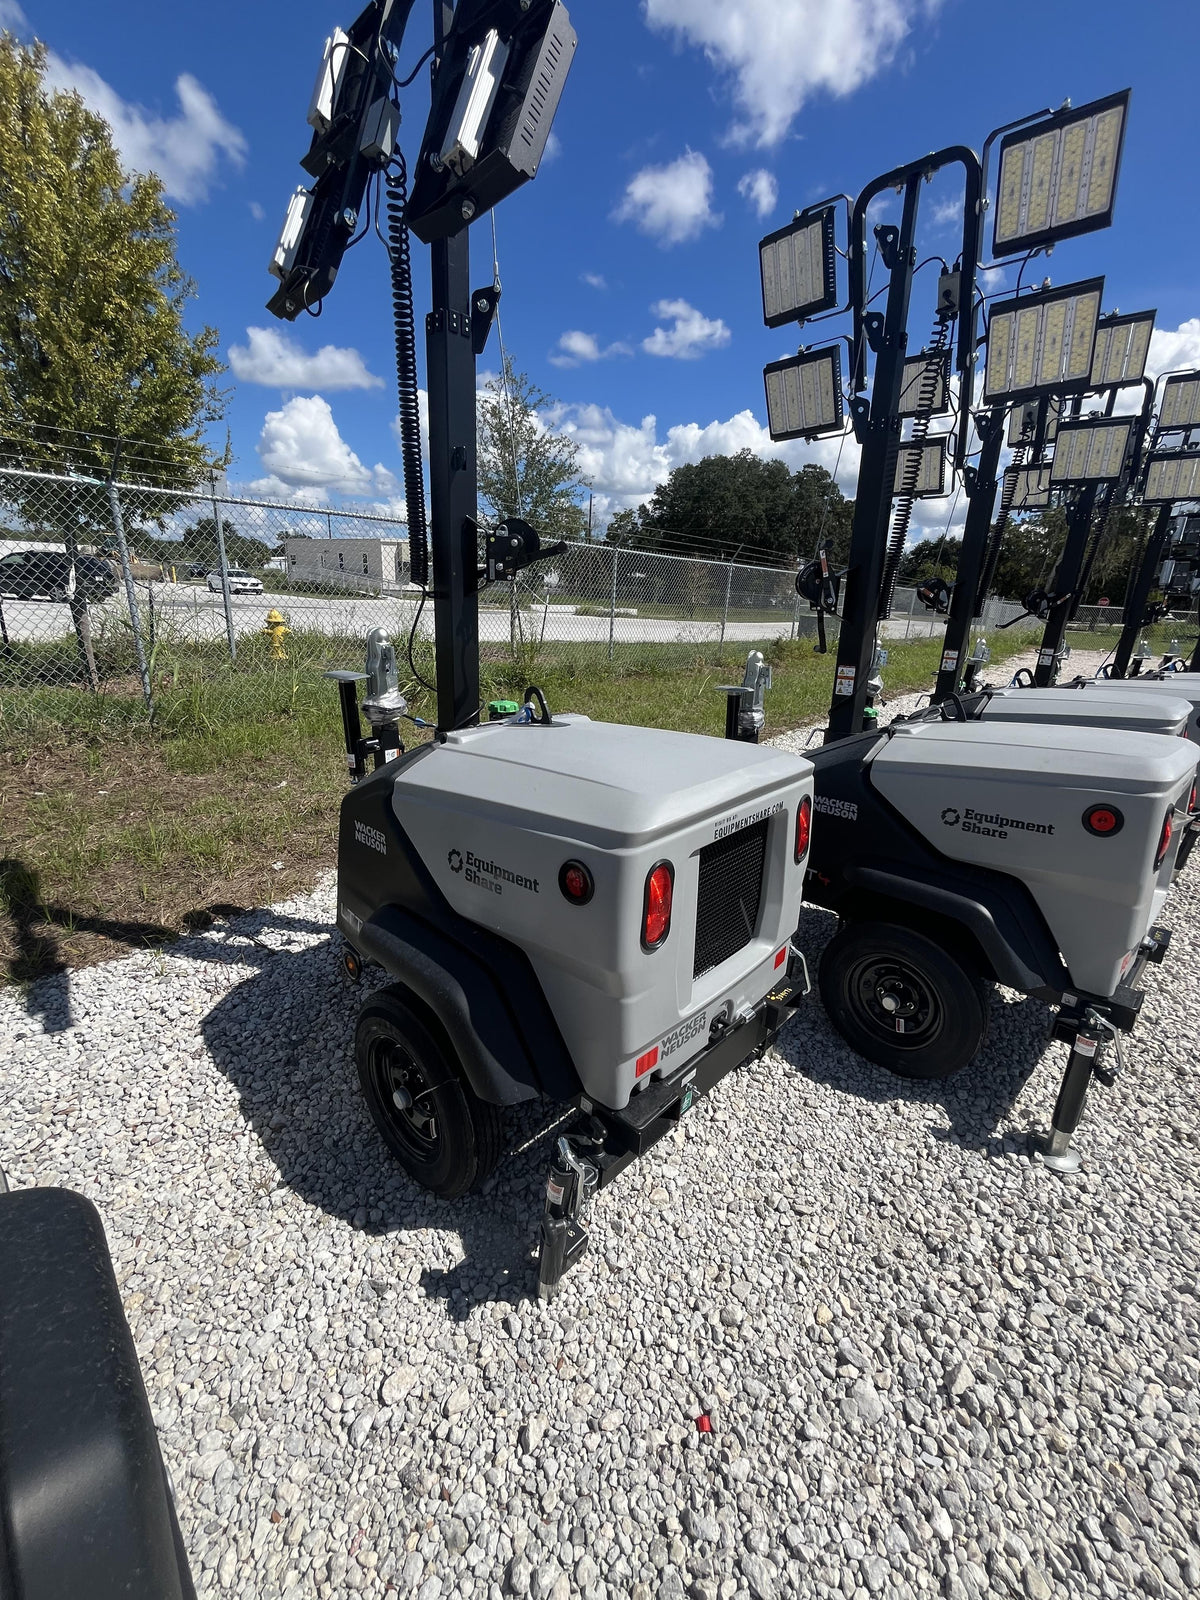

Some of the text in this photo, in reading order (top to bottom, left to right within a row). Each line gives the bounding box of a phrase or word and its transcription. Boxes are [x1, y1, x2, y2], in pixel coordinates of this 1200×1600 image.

[814, 795, 858, 812] WACKER
[814, 803, 857, 821] NEUSON
[354, 819, 386, 844] WACKER
[714, 801, 784, 839] EQUIPMENTSHARE.COM
[961, 821, 1008, 839] Share
[964, 808, 1055, 835] Equipment
[355, 830, 387, 855] NEUSON
[465, 868, 502, 895] Share
[466, 851, 540, 893] Equipment
[660, 1020, 706, 1061] NEUSON
[661, 1011, 706, 1048] WACKER
